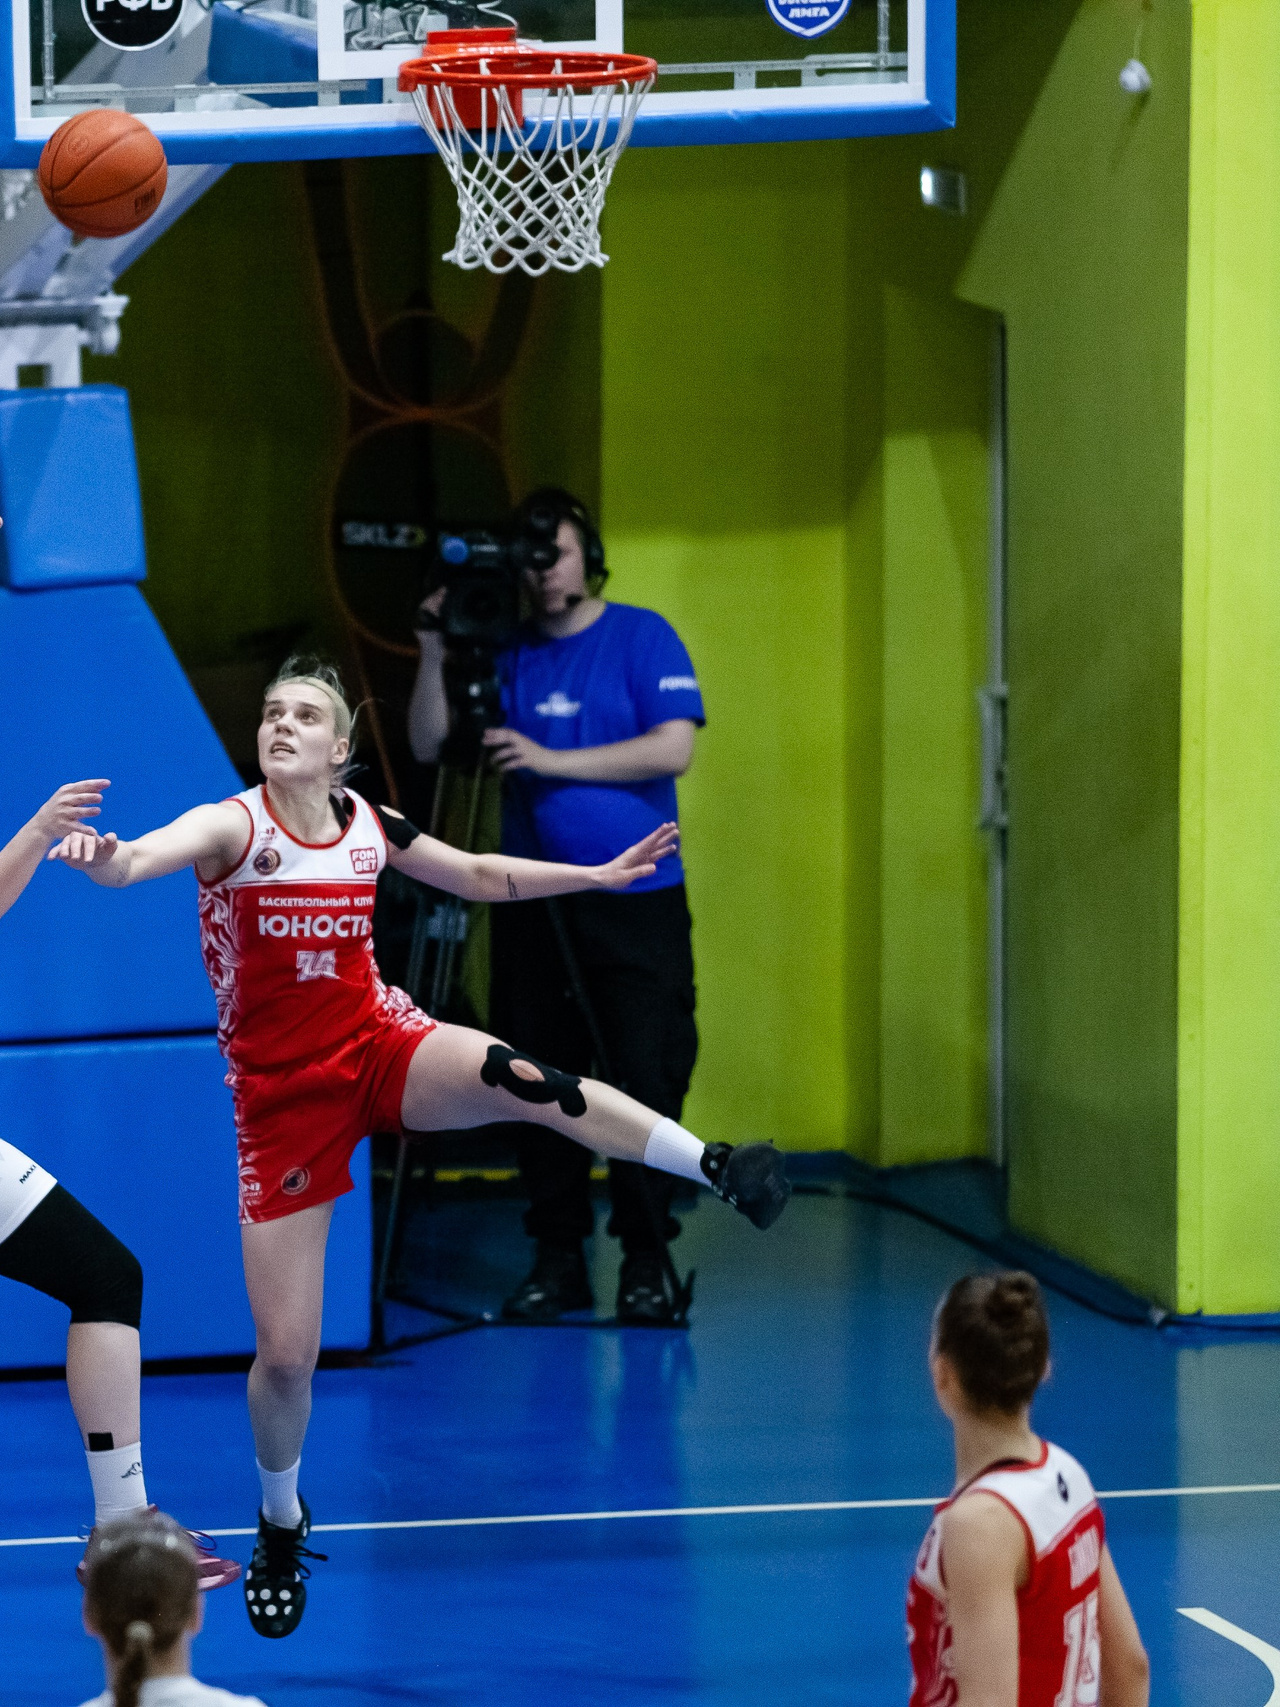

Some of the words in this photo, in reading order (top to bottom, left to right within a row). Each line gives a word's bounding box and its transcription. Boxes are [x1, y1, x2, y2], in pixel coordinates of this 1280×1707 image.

[352, 848, 376, 861] FON
[354, 859, 376, 872] BET
[258, 896, 351, 907] БАСКЕТБОЛЬНЫЙ
